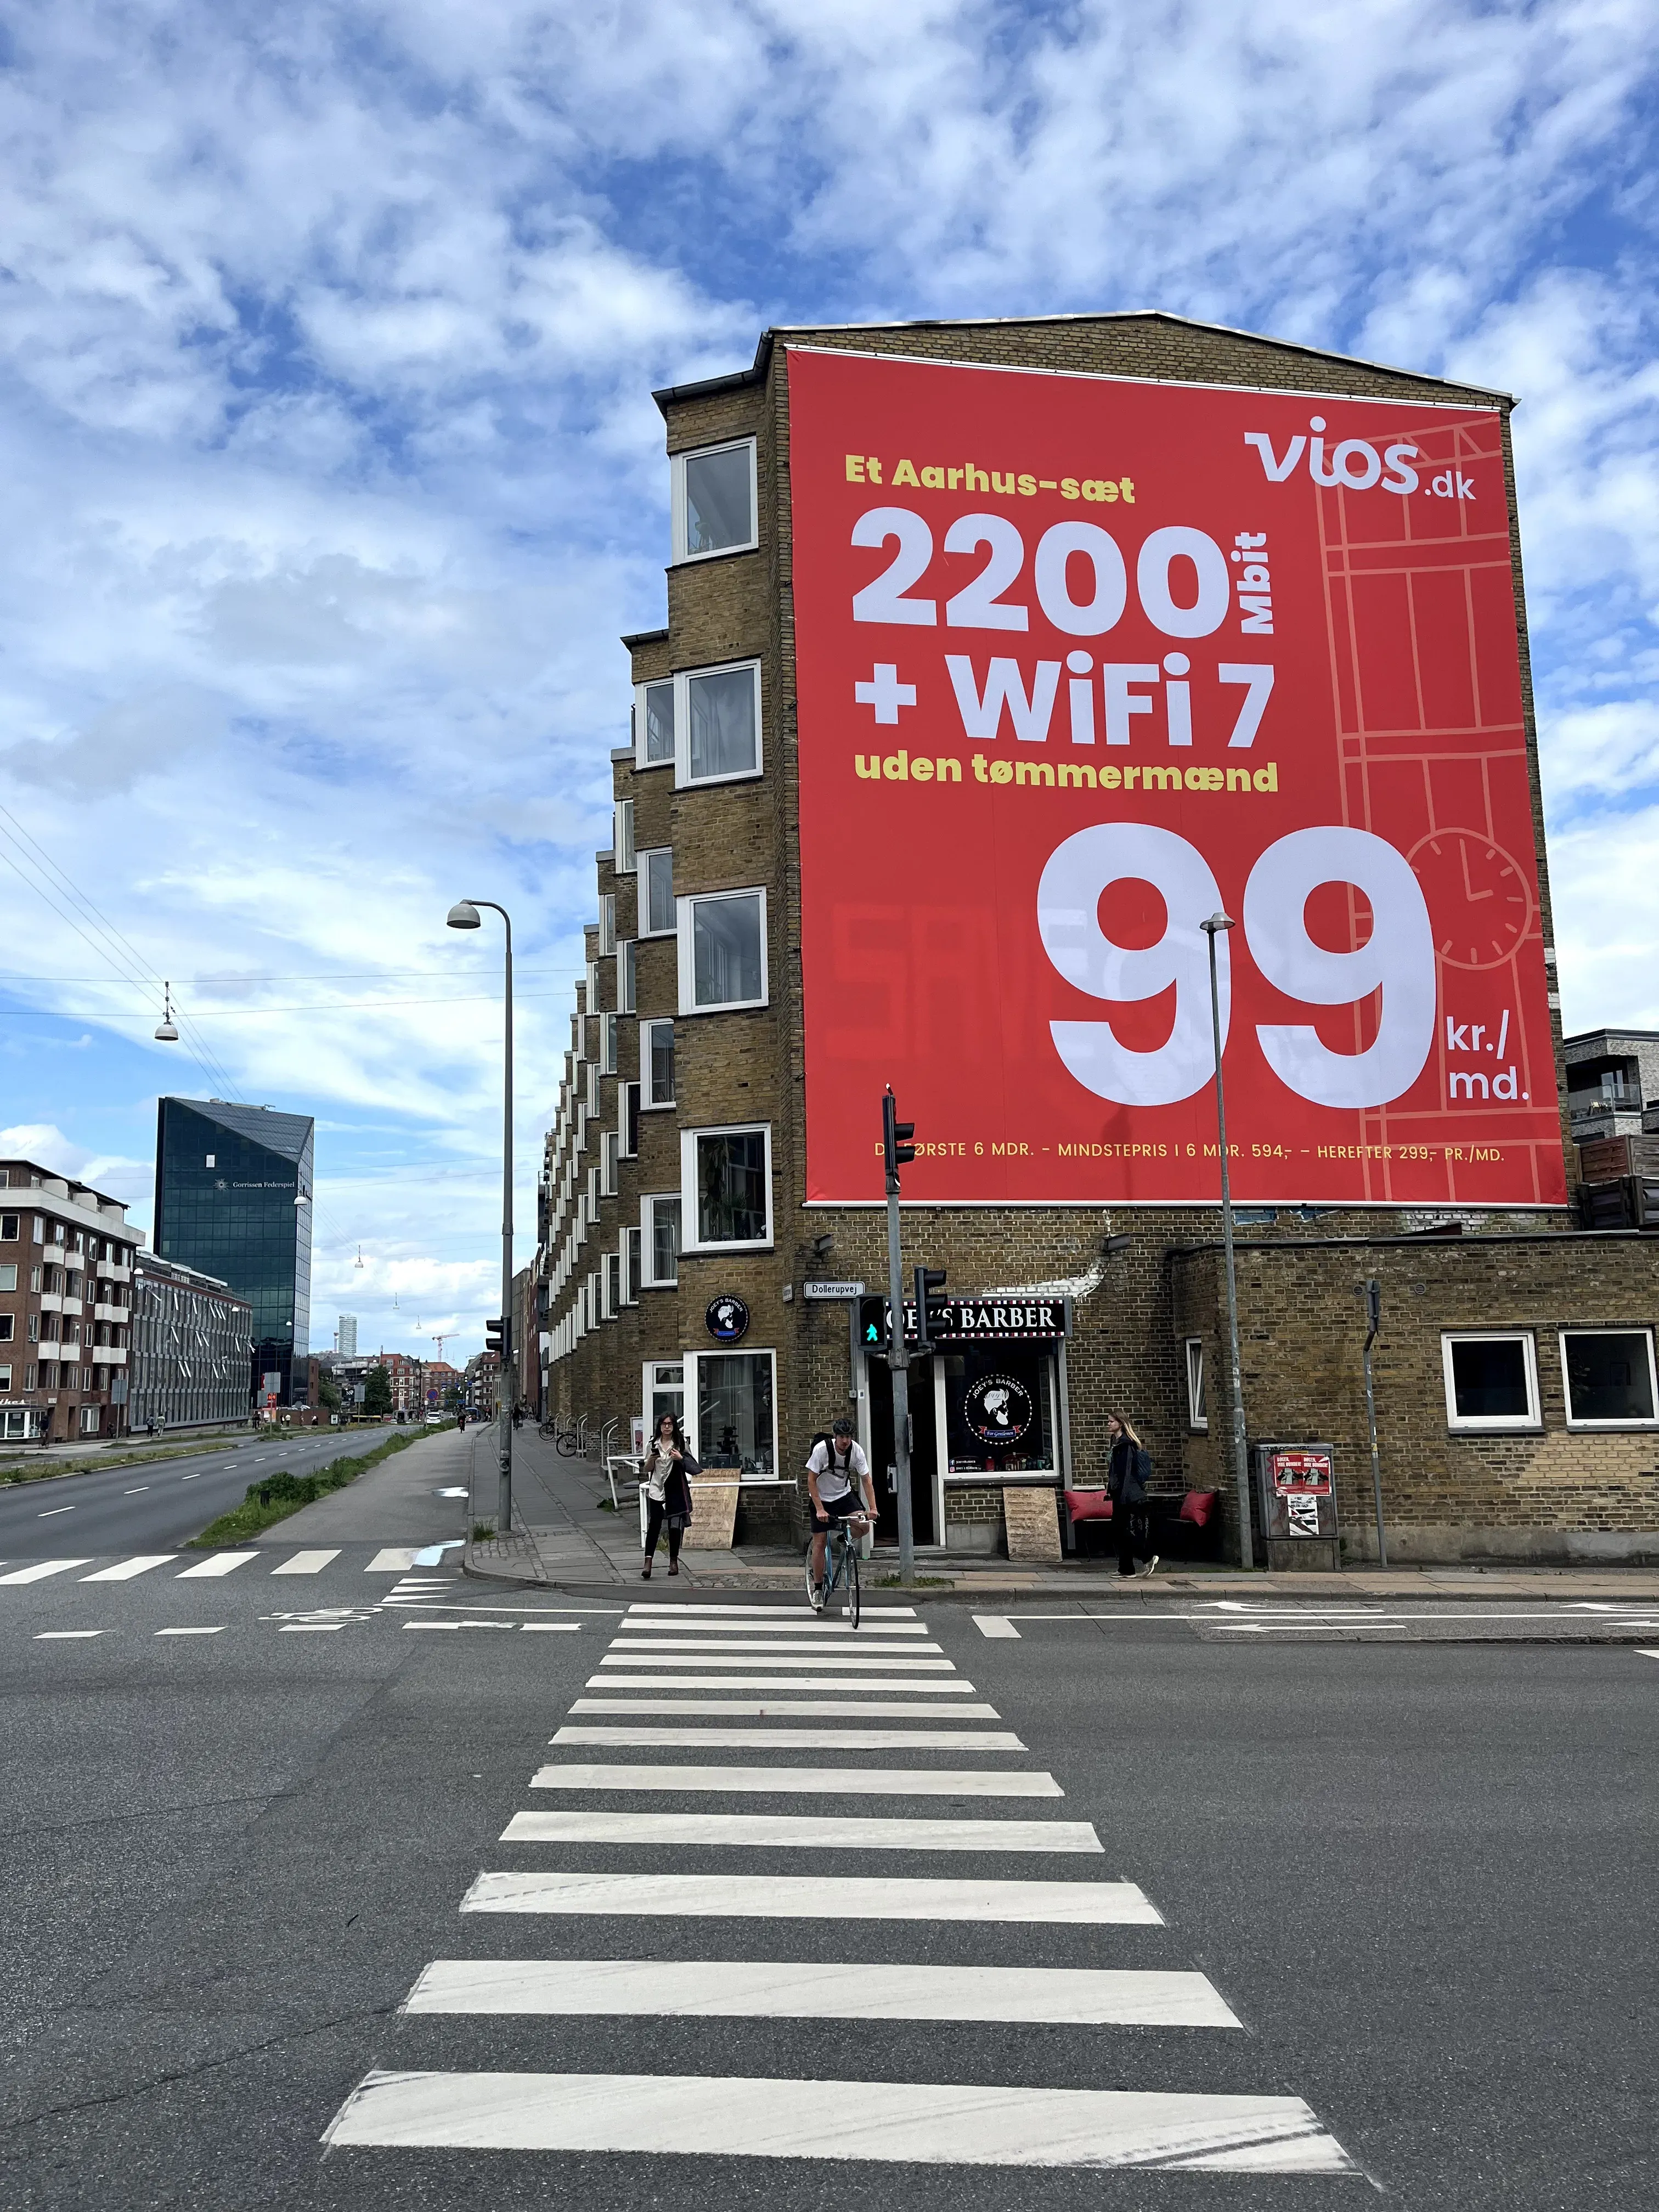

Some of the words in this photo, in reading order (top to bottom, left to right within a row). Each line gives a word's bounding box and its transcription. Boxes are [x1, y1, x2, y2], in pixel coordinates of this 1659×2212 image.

[845, 454, 883, 484] Et
[891, 459, 1135, 503] Aarhus-sæt
[850, 506, 1230, 639] 2200
[1230, 532, 1274, 635] Mbit
[944, 650, 1193, 746] WiFi
[1218, 663, 1275, 748] 7
[855, 749, 962, 782] uden
[971, 753, 1279, 792] tømmermænd
[1037, 822, 1437, 1109] 99
[1446, 1009, 1510, 1060] kr./
[1449, 1066, 1530, 1100] md.
[904, 1142, 967, 1156] ØRSTE
[974, 1142, 984, 1156] 6
[991, 1142, 1035, 1156] MDR.
[1058, 1143, 1168, 1157] MINDSTEPRIS
[1186, 1143, 1197, 1157] 6
[1317, 1145, 1393, 1159] HEREFTER
[812, 1284, 857, 1295] Dollerupvej
[960, 1308, 1057, 1328] BARBER
[973, 1379, 993, 1399] JOEY'S
[996, 1378, 1024, 1397] BARBER
